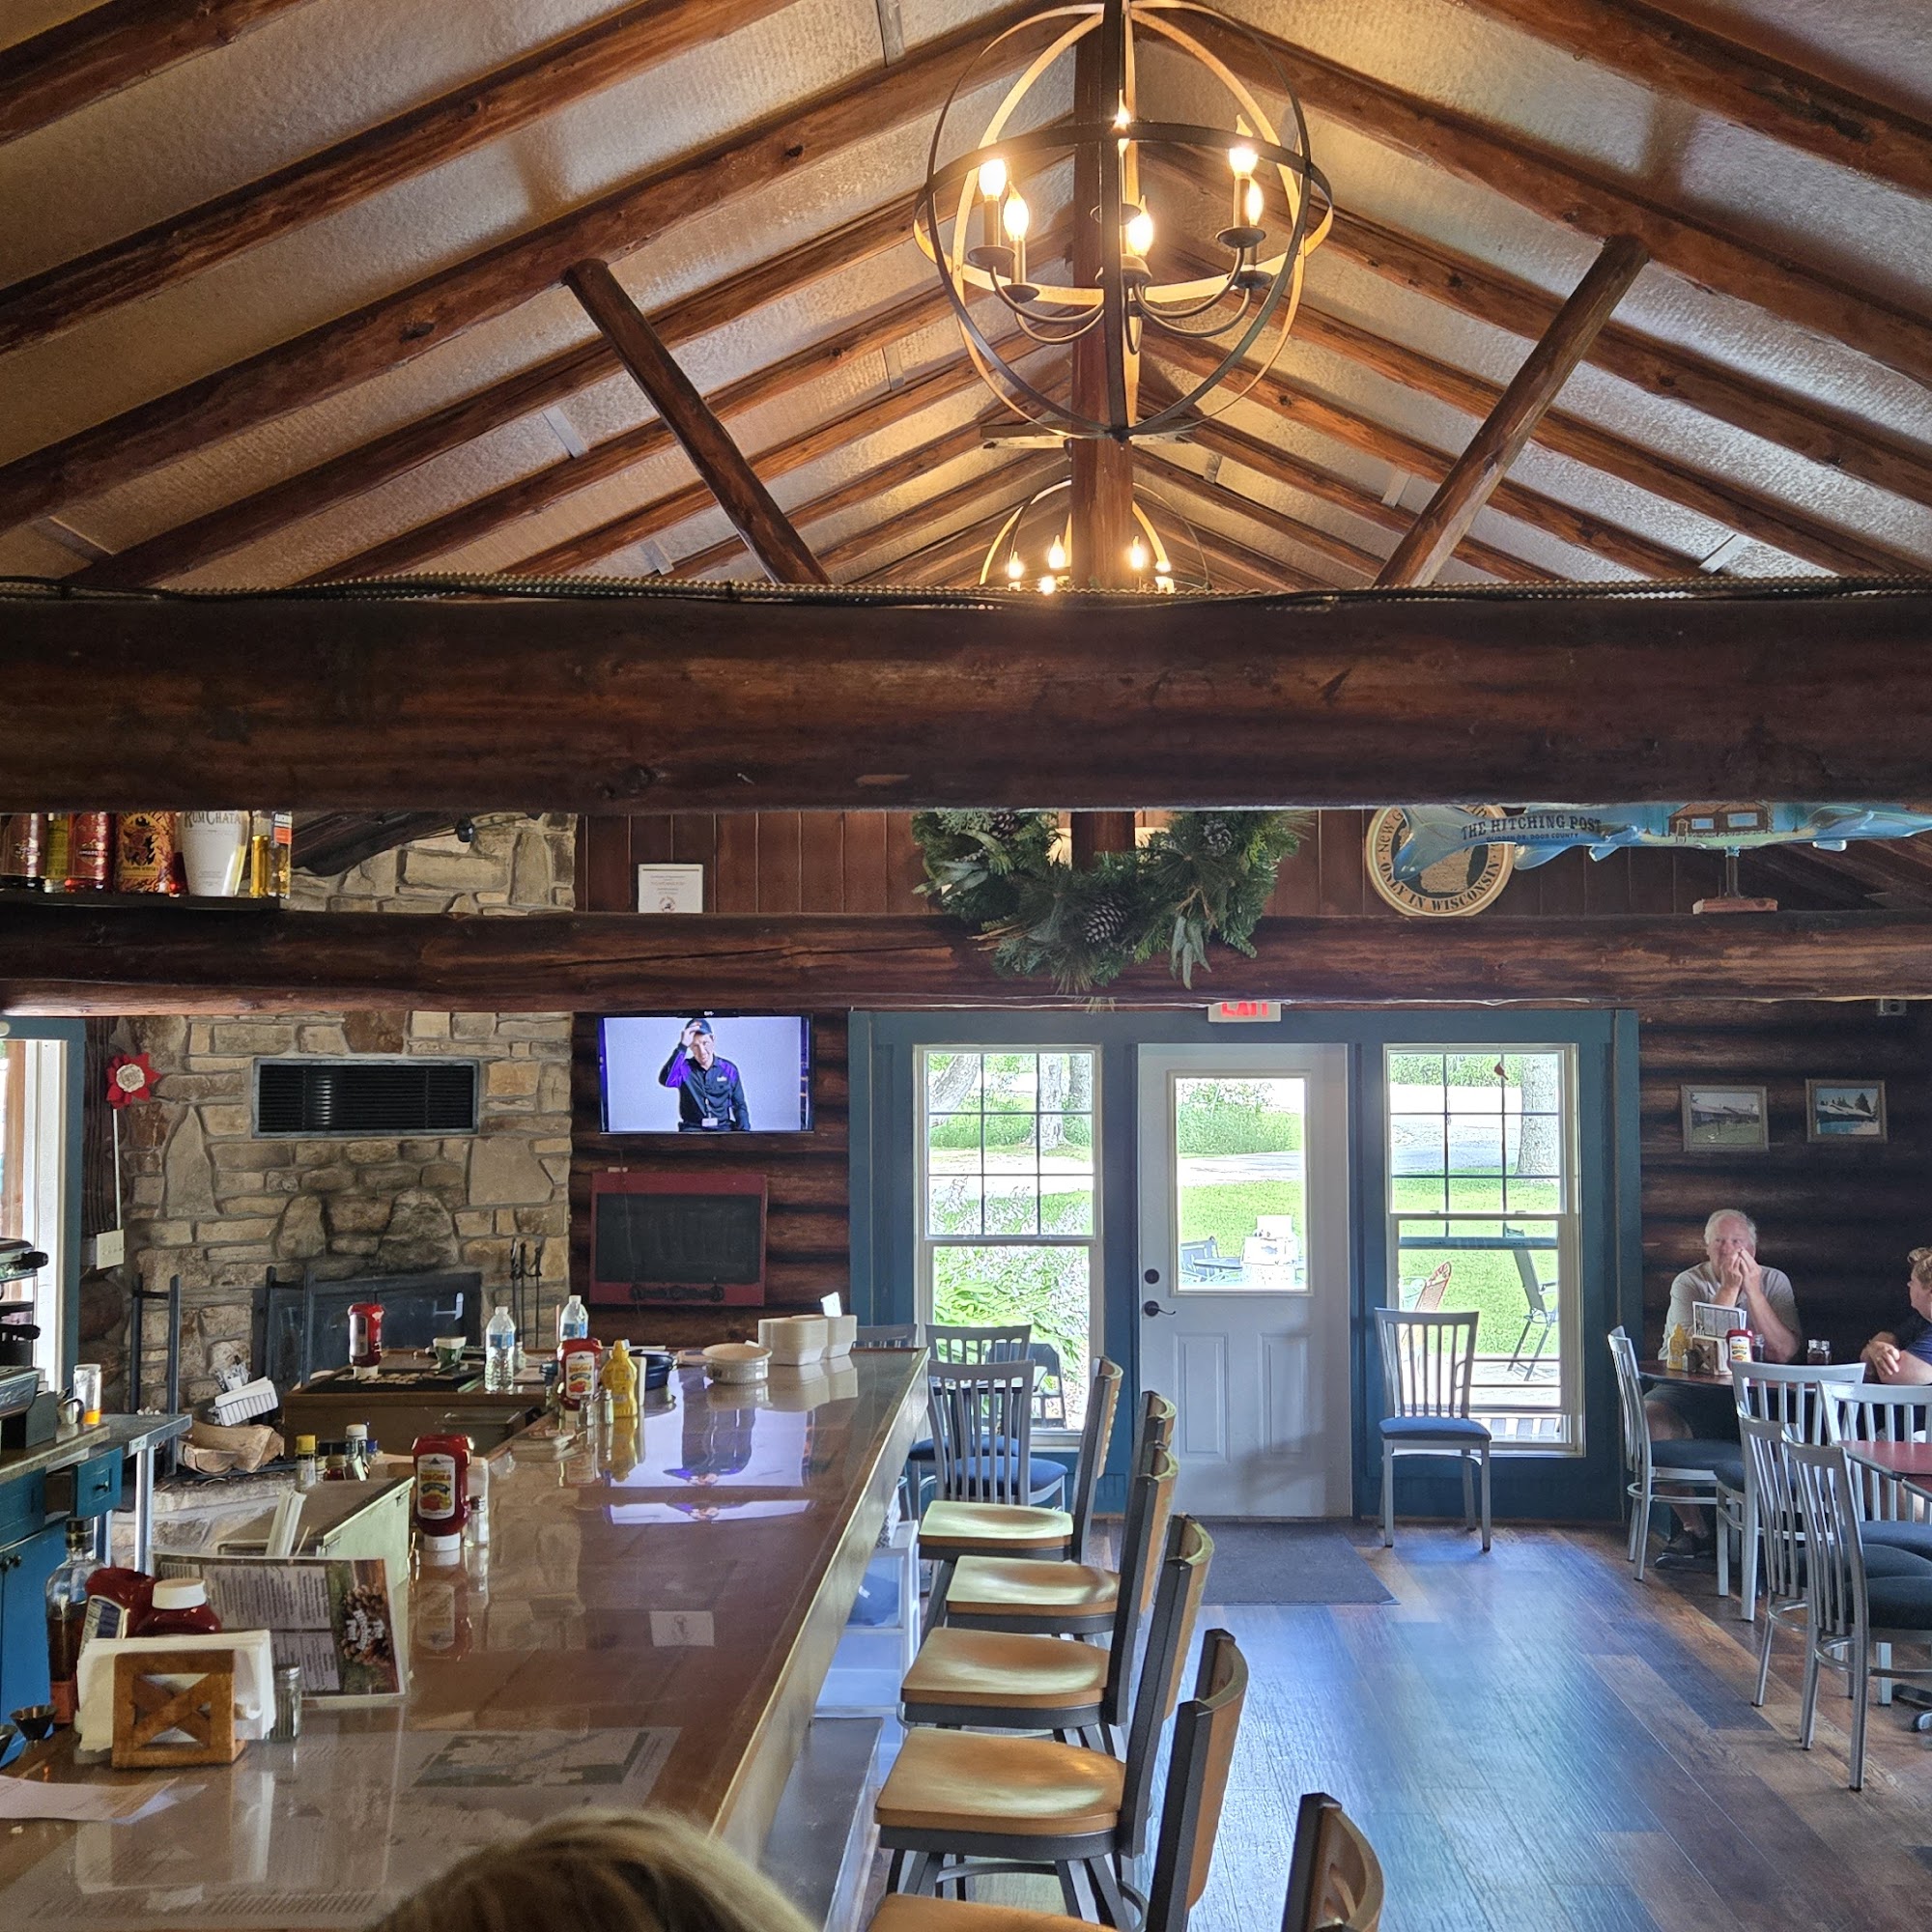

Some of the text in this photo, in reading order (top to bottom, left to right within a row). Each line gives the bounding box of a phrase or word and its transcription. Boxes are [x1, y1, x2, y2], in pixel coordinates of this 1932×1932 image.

[1462, 814, 1602, 840] THE HITCHING POST
[1380, 860, 1500, 911] ONLY IN WISCONSIN
